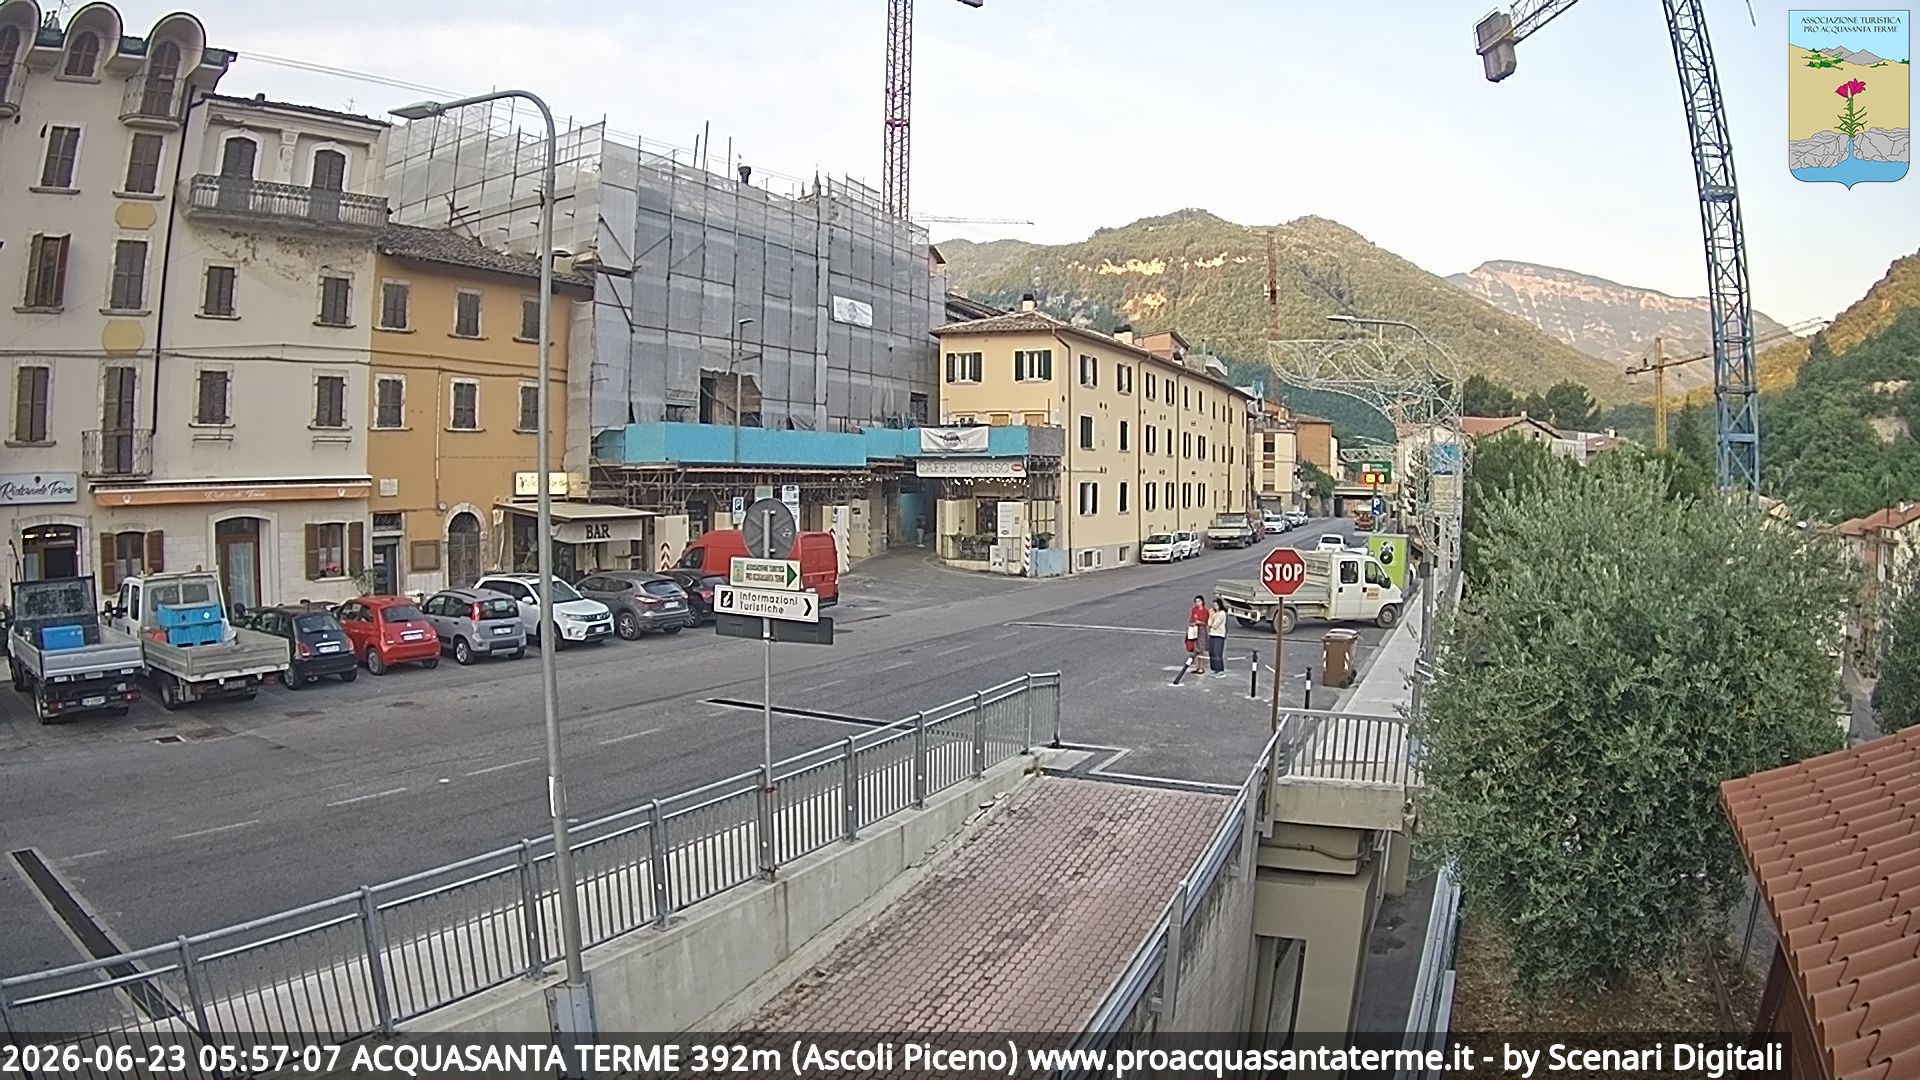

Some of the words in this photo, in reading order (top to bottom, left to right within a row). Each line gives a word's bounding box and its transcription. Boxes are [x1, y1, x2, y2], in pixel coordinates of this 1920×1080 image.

[970, 462, 1010, 473] CORSO
[585, 523, 611, 539] BAR
[1264, 562, 1303, 582] STOP
[739, 591, 798, 606] Informazioni
[739, 601, 784, 614] Turistiche
